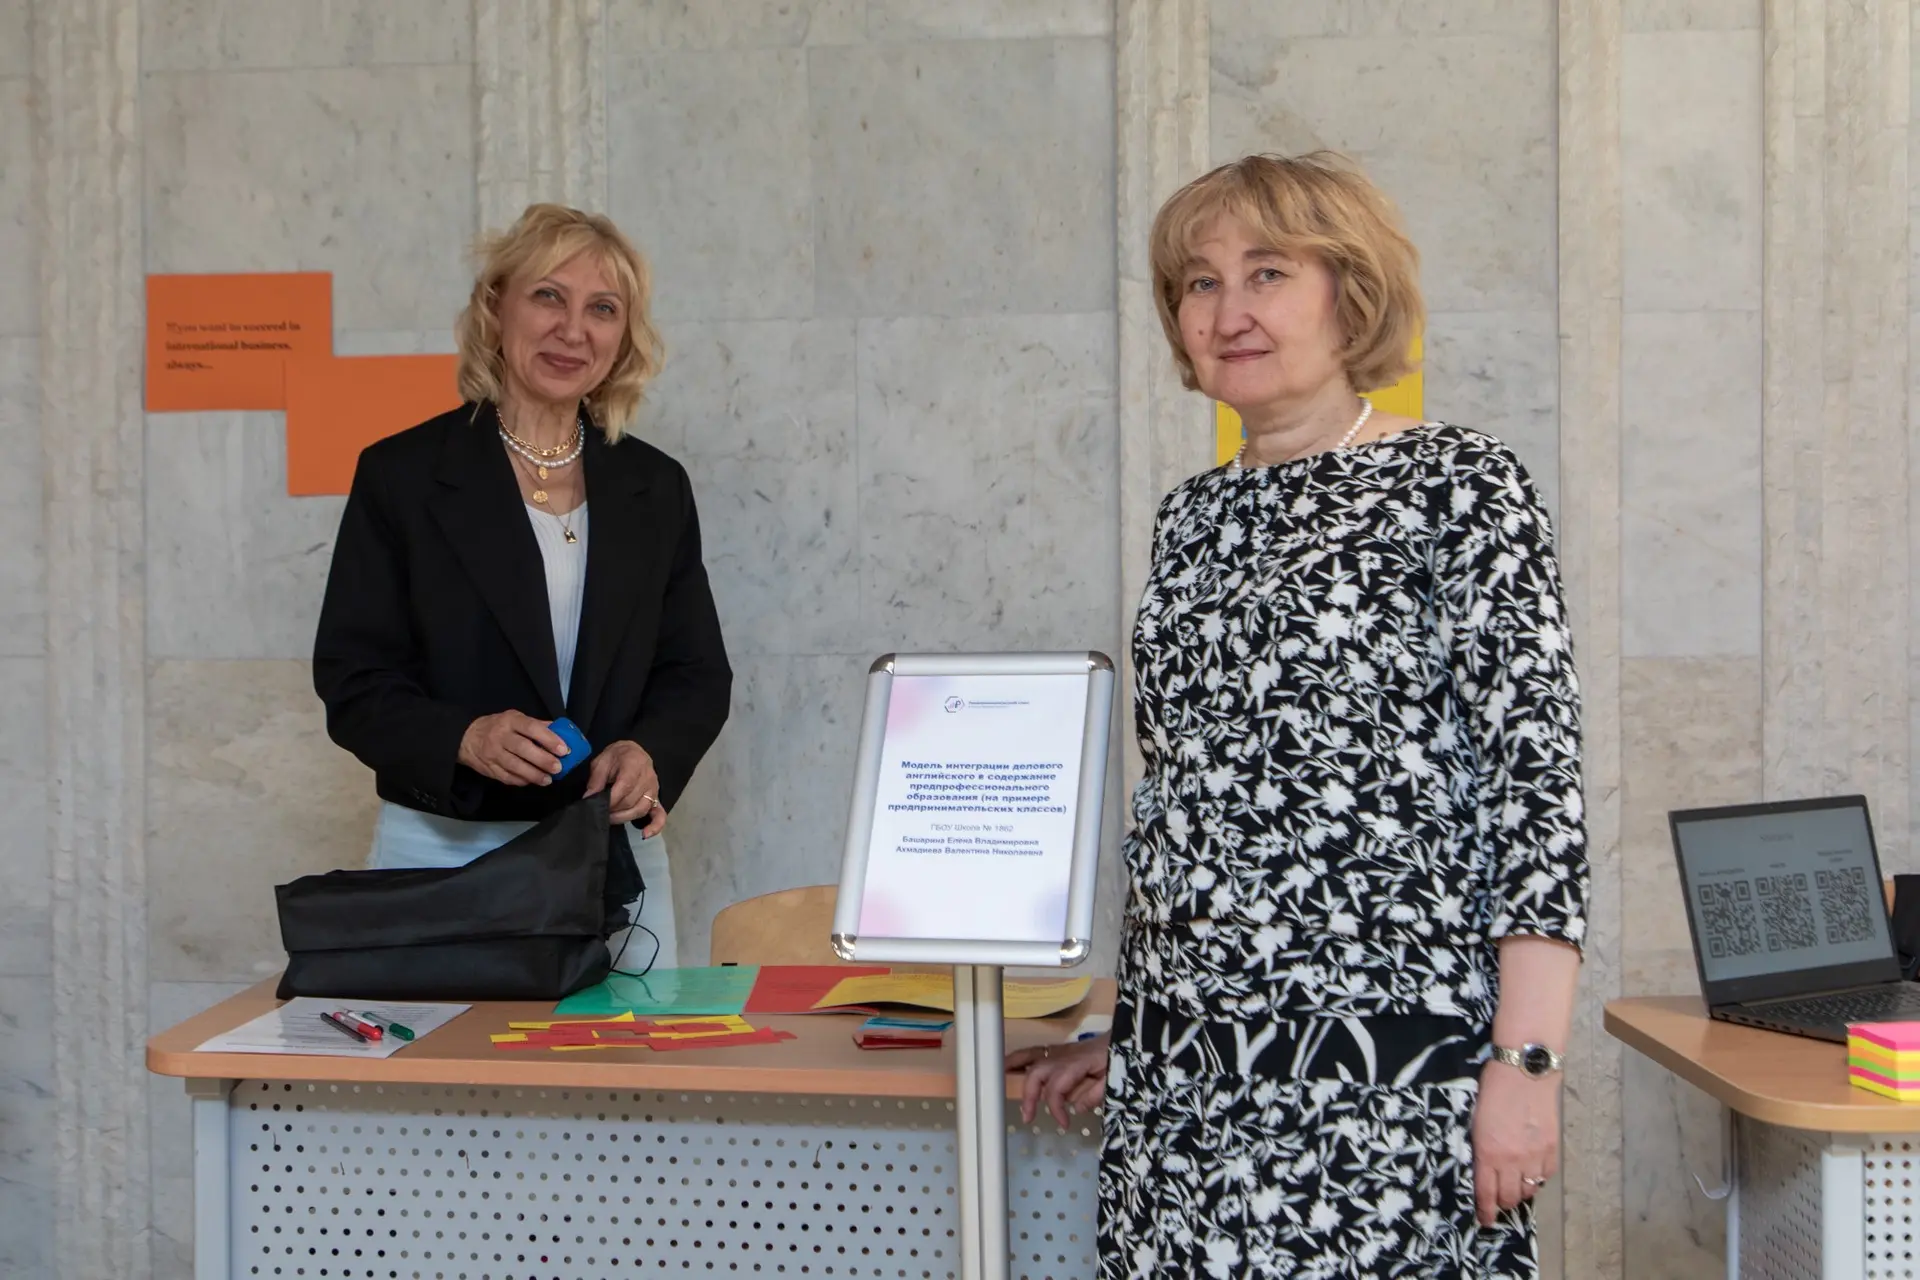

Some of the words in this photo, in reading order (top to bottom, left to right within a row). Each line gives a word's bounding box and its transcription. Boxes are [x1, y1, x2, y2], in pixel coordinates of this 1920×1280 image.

[199, 322, 227, 332] want
[229, 322, 241, 332] to
[243, 321, 286, 332] succeed
[288, 320, 301, 331] in
[901, 761, 943, 770] Модель
[946, 762, 1010, 771] интеграции
[1012, 763, 1064, 771] делового
[905, 772, 976, 781] английского
[987, 773, 1057, 782] содержание
[909, 783, 1050, 792] предпрофессионального
[906, 792, 978, 801] образования
[981, 794, 999, 803] (на
[1002, 795, 1050, 803] примере
[888, 803, 1014, 813] предпринимательских
[1016, 805, 1067, 815] классов)
[931, 823, 952, 832] ГБОУ
[954, 824, 981, 832] Школа
[902, 835, 945, 845] Башарина
[974, 837, 1040, 846] Владимировна
[895, 846, 943, 855] Ахмадиева
[944, 847, 990, 855] Валентина
[992, 848, 1043, 857] Николаевна
